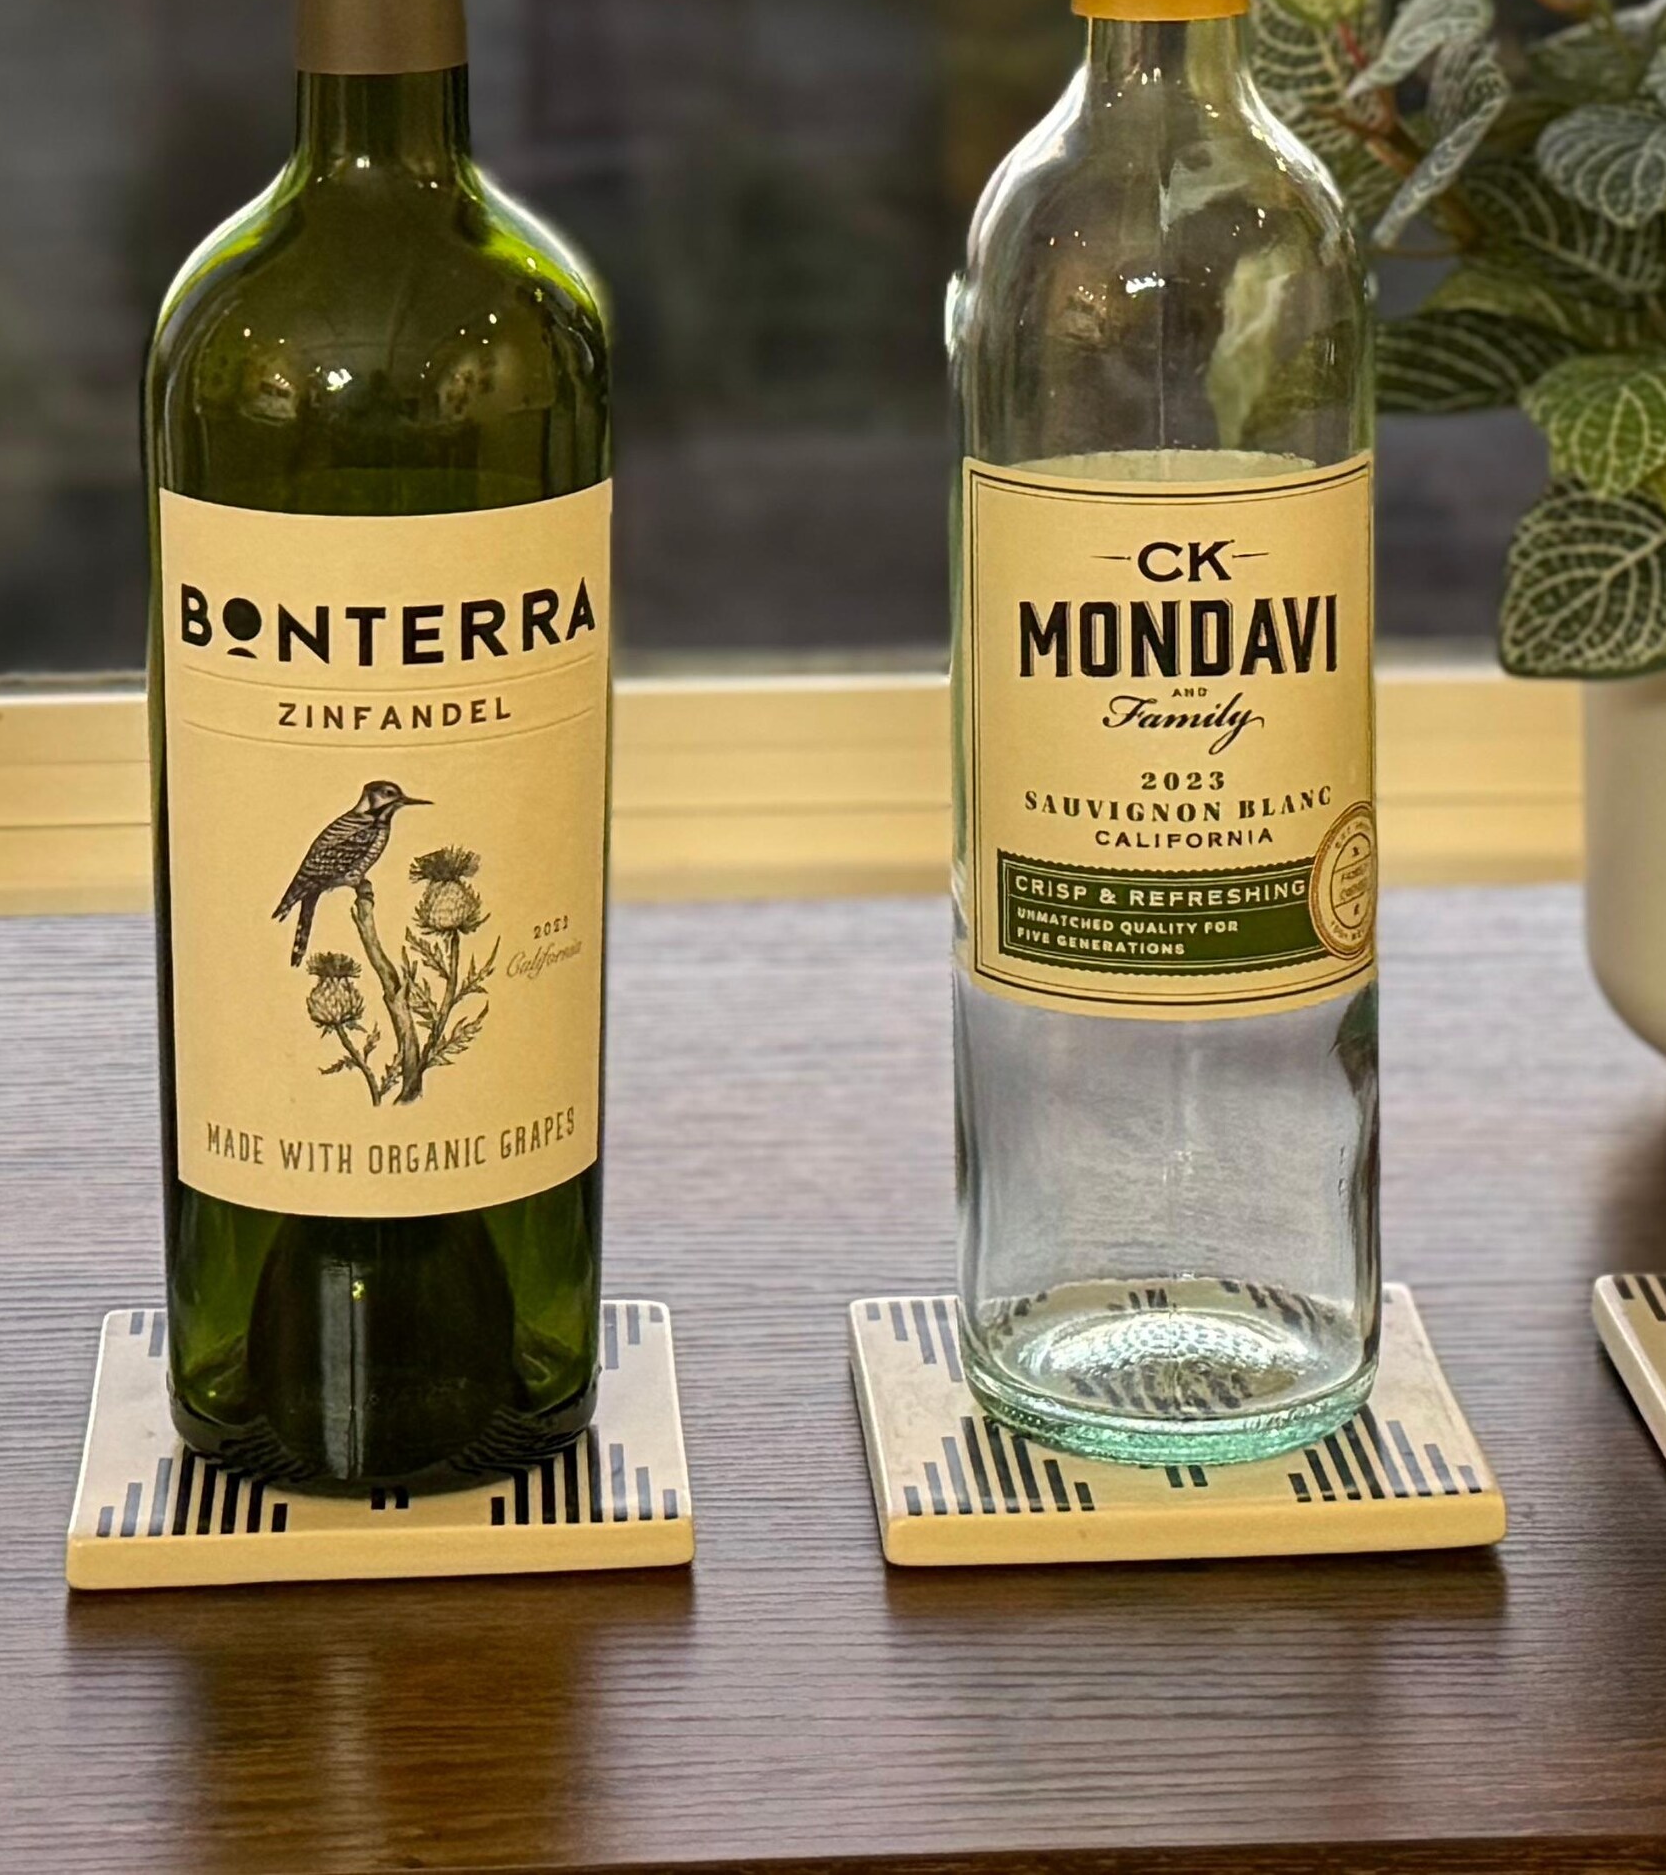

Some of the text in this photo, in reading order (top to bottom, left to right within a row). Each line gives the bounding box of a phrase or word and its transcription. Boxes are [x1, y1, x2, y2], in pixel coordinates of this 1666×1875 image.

[1137, 538, 1235, 582] CK
[180, 576, 597, 667] BONTERRA
[1019, 594, 1337, 678] MONDAVI
[1171, 687, 1207, 698] AND
[278, 696, 512, 731] ZINFANDEL
[1101, 692, 1265, 756] Family
[1140, 771, 1226, 791] 2023
[1024, 785, 1332, 823] SAUVIGNON BLANC
[1095, 827, 1274, 849] CALIFORNIA
[1015, 874, 1306, 908] CRISP & REFRESHING
[1017, 906, 1239, 936] UNMATCHED QUALITY FOR
[1017, 926, 1185, 956] FIVE GENERATIONS
[506, 940, 582, 981] California
[206, 1105, 576, 1175] MADE WITH ORGANIC GRAPES
